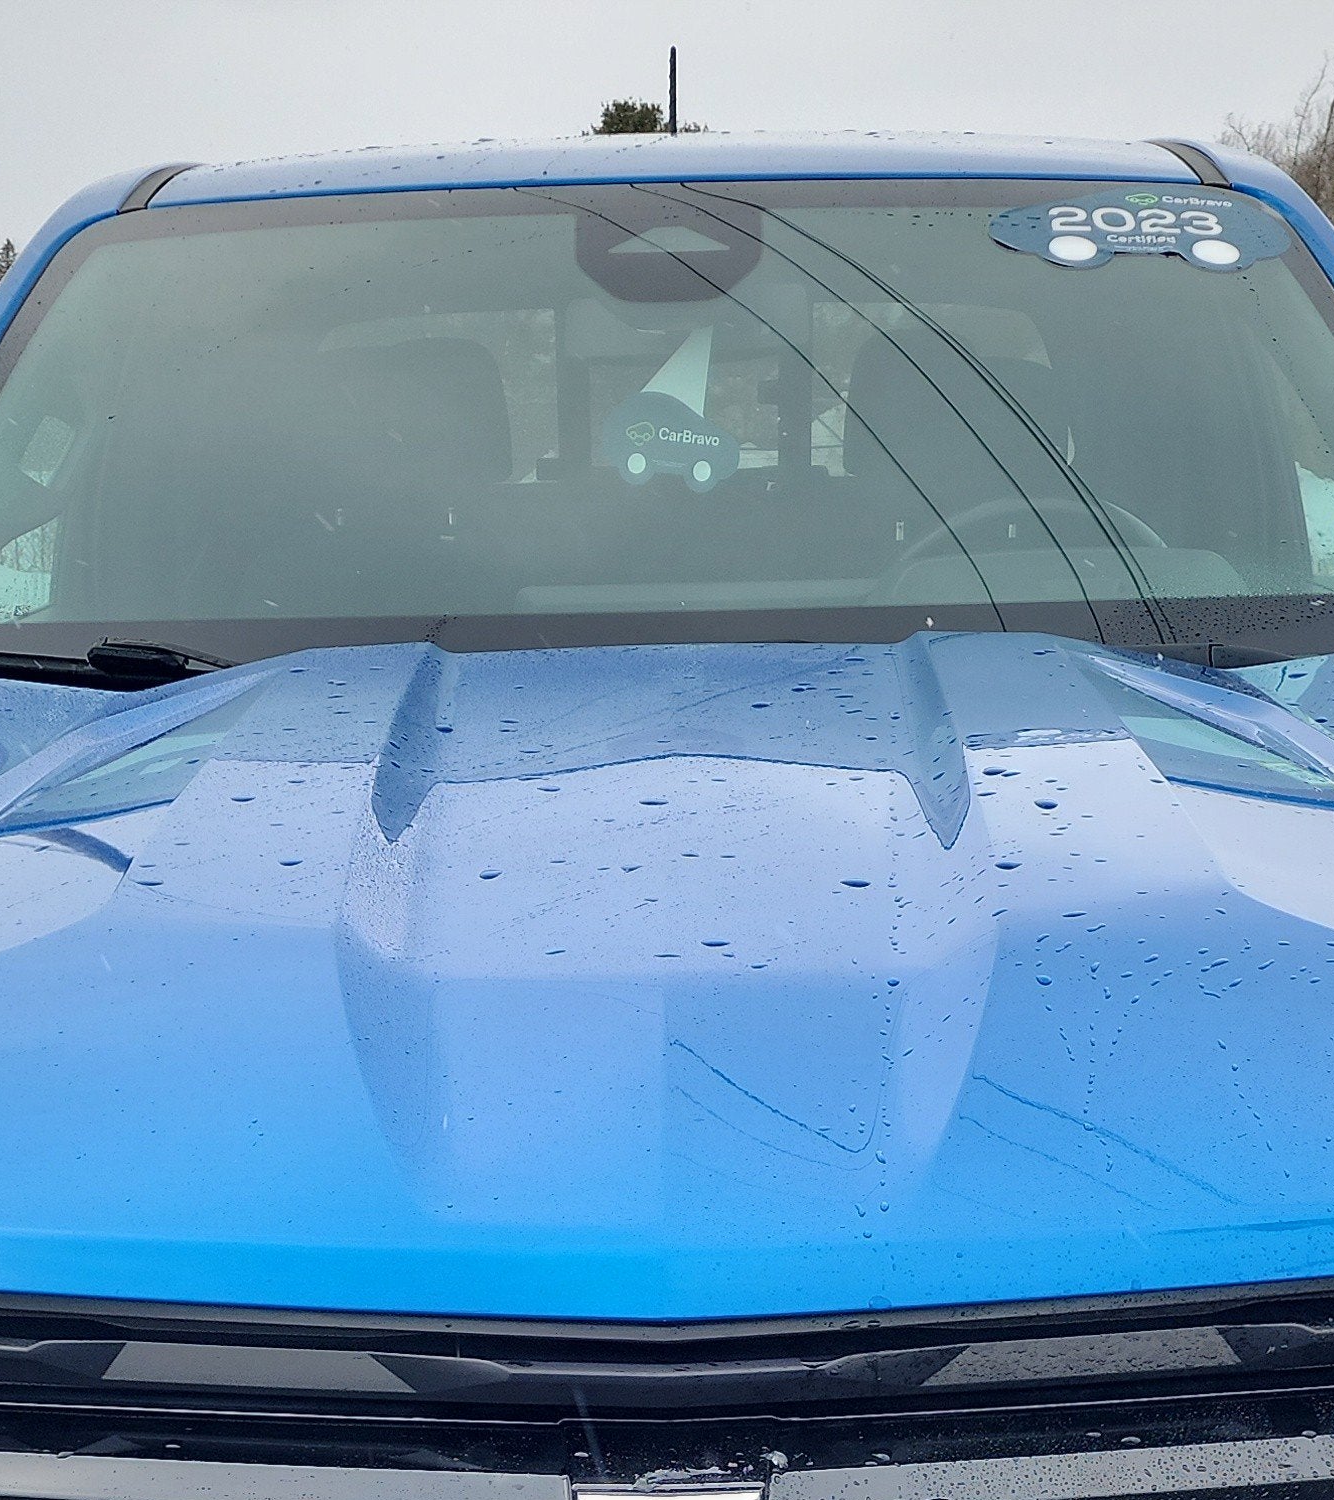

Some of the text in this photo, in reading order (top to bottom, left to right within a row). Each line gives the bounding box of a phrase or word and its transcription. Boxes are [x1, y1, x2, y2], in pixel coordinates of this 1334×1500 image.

[1161, 195, 1233, 207] CarBravo
[1048, 206, 1223, 236] 2023
[1106, 234, 1176, 244] Certified
[658, 427, 720, 447] CarBravo
